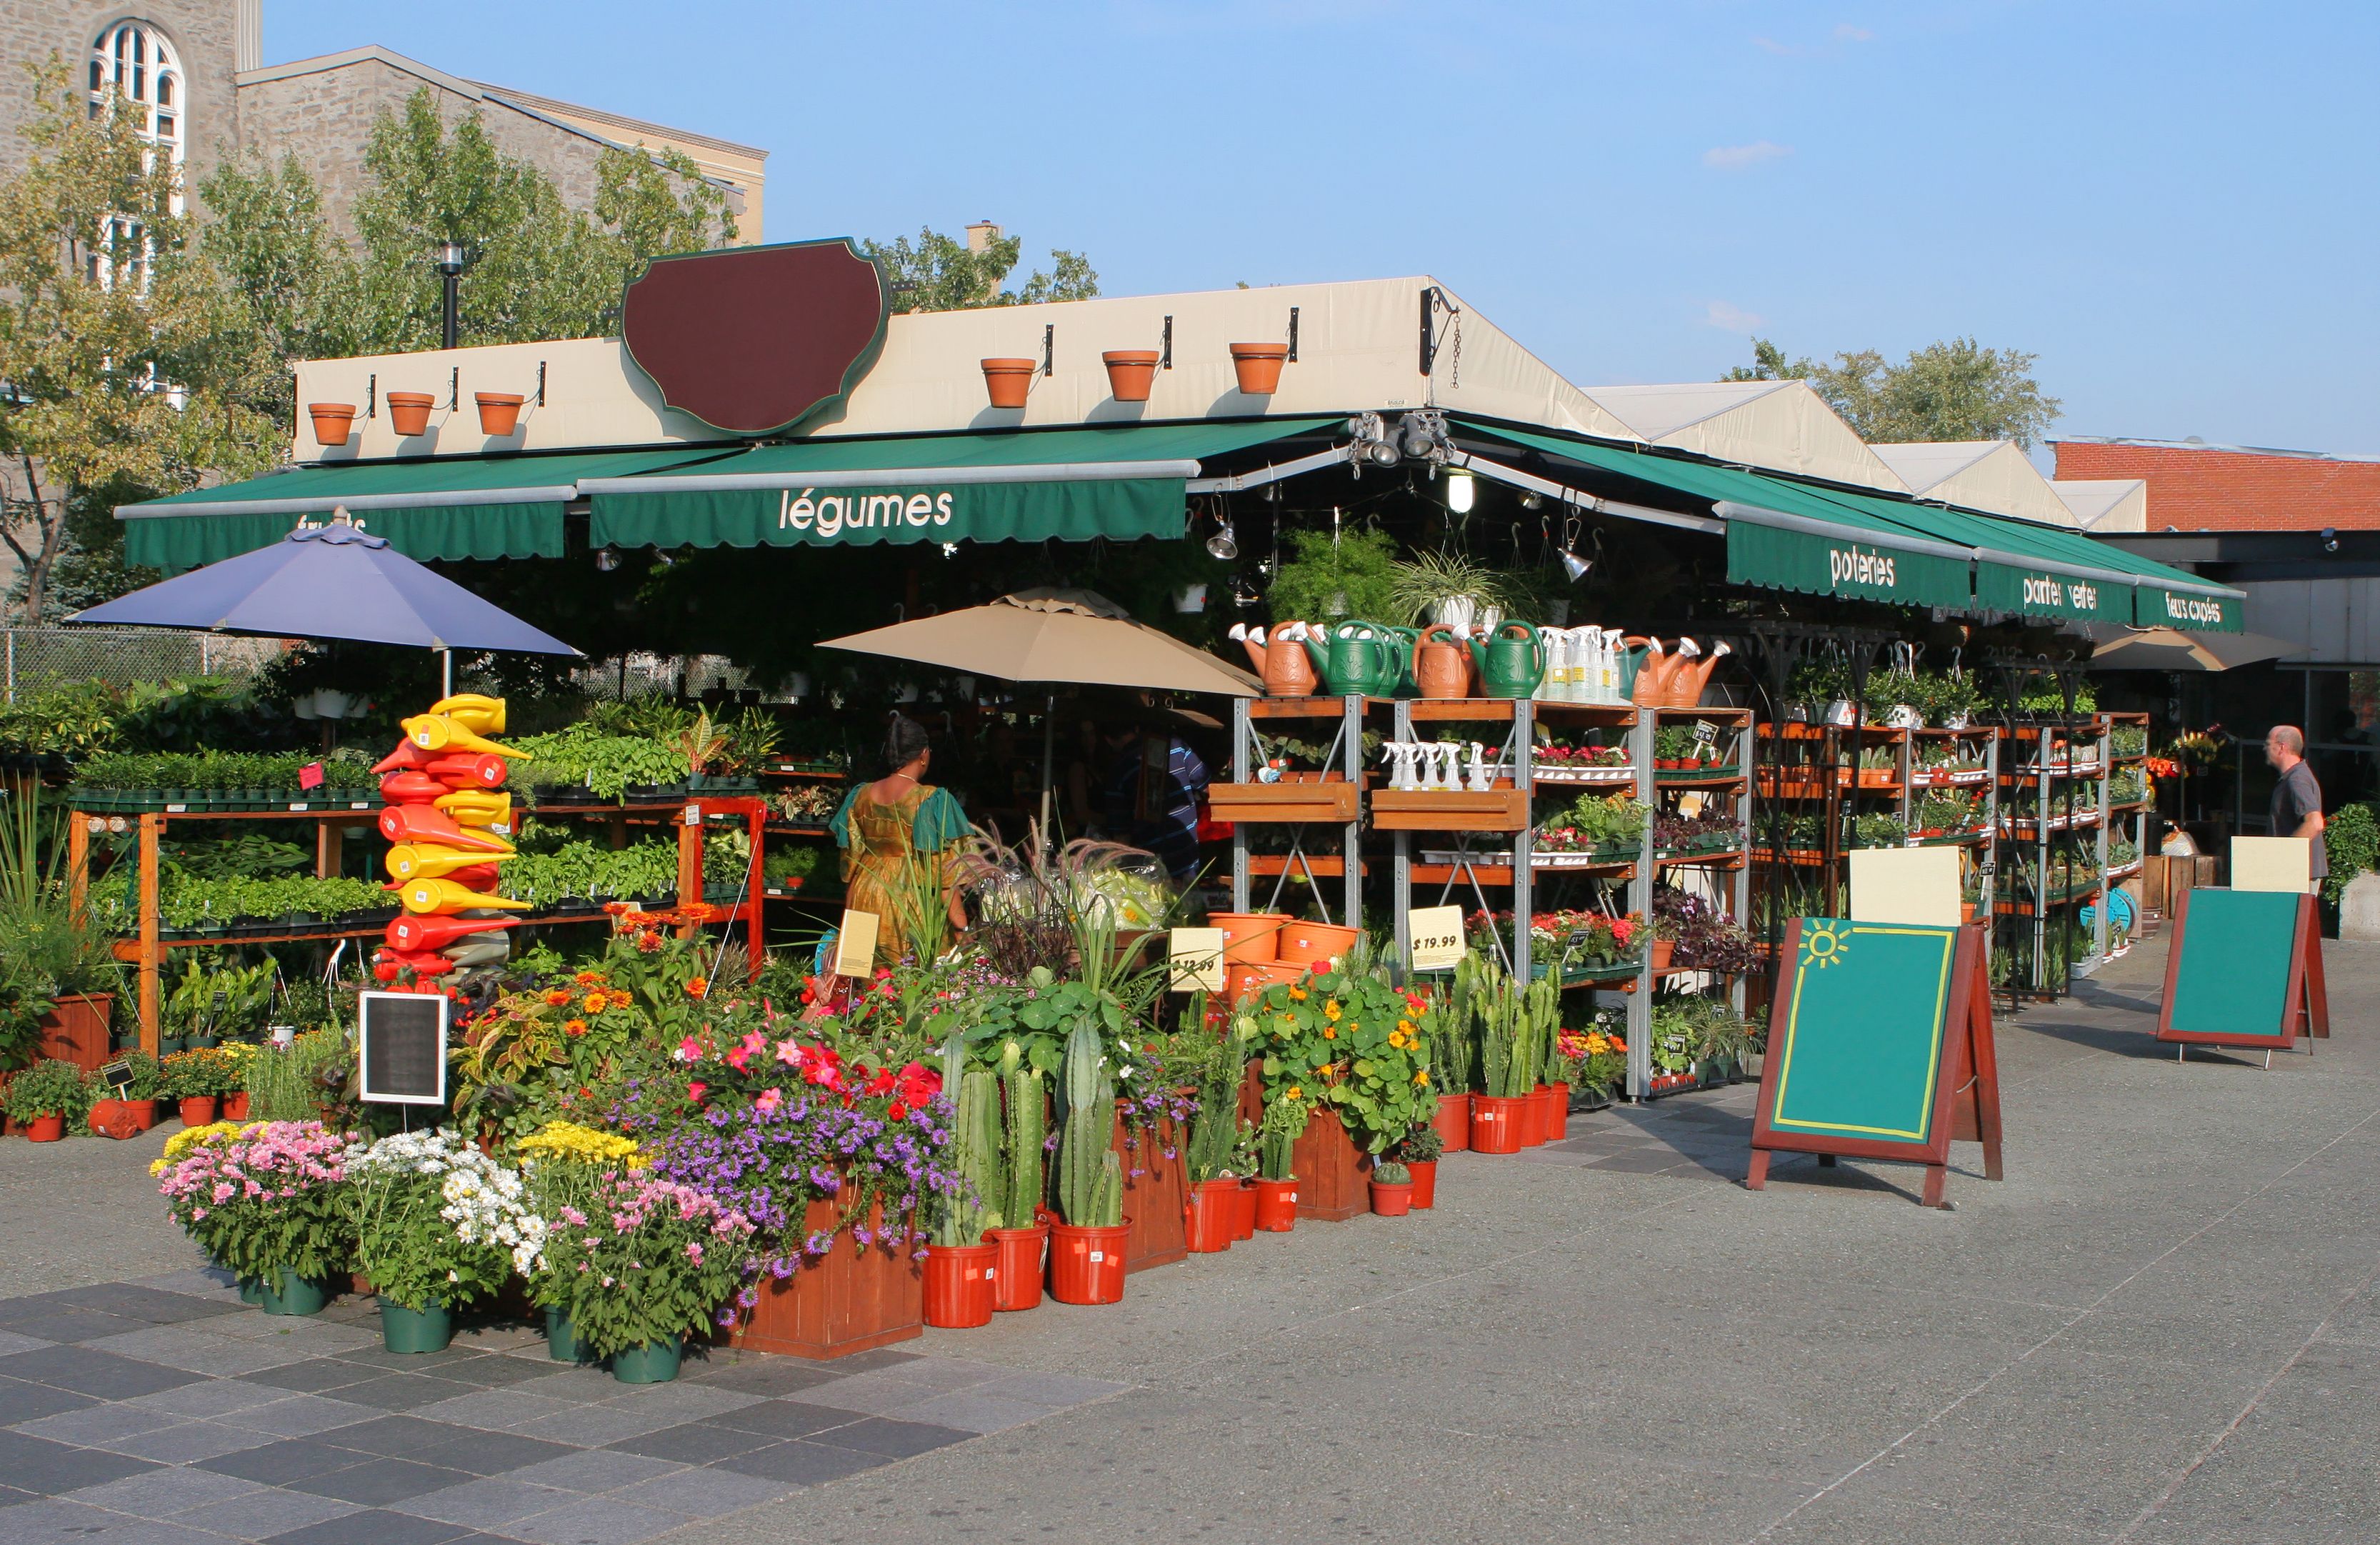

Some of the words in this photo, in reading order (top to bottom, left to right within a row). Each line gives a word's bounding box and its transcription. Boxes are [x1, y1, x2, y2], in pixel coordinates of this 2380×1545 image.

[779, 488, 954, 538] légumes
[1830, 545, 1895, 588] poteries
[1424, 935, 1456, 949] 19.99
[1184, 960, 1214, 971] 1299
